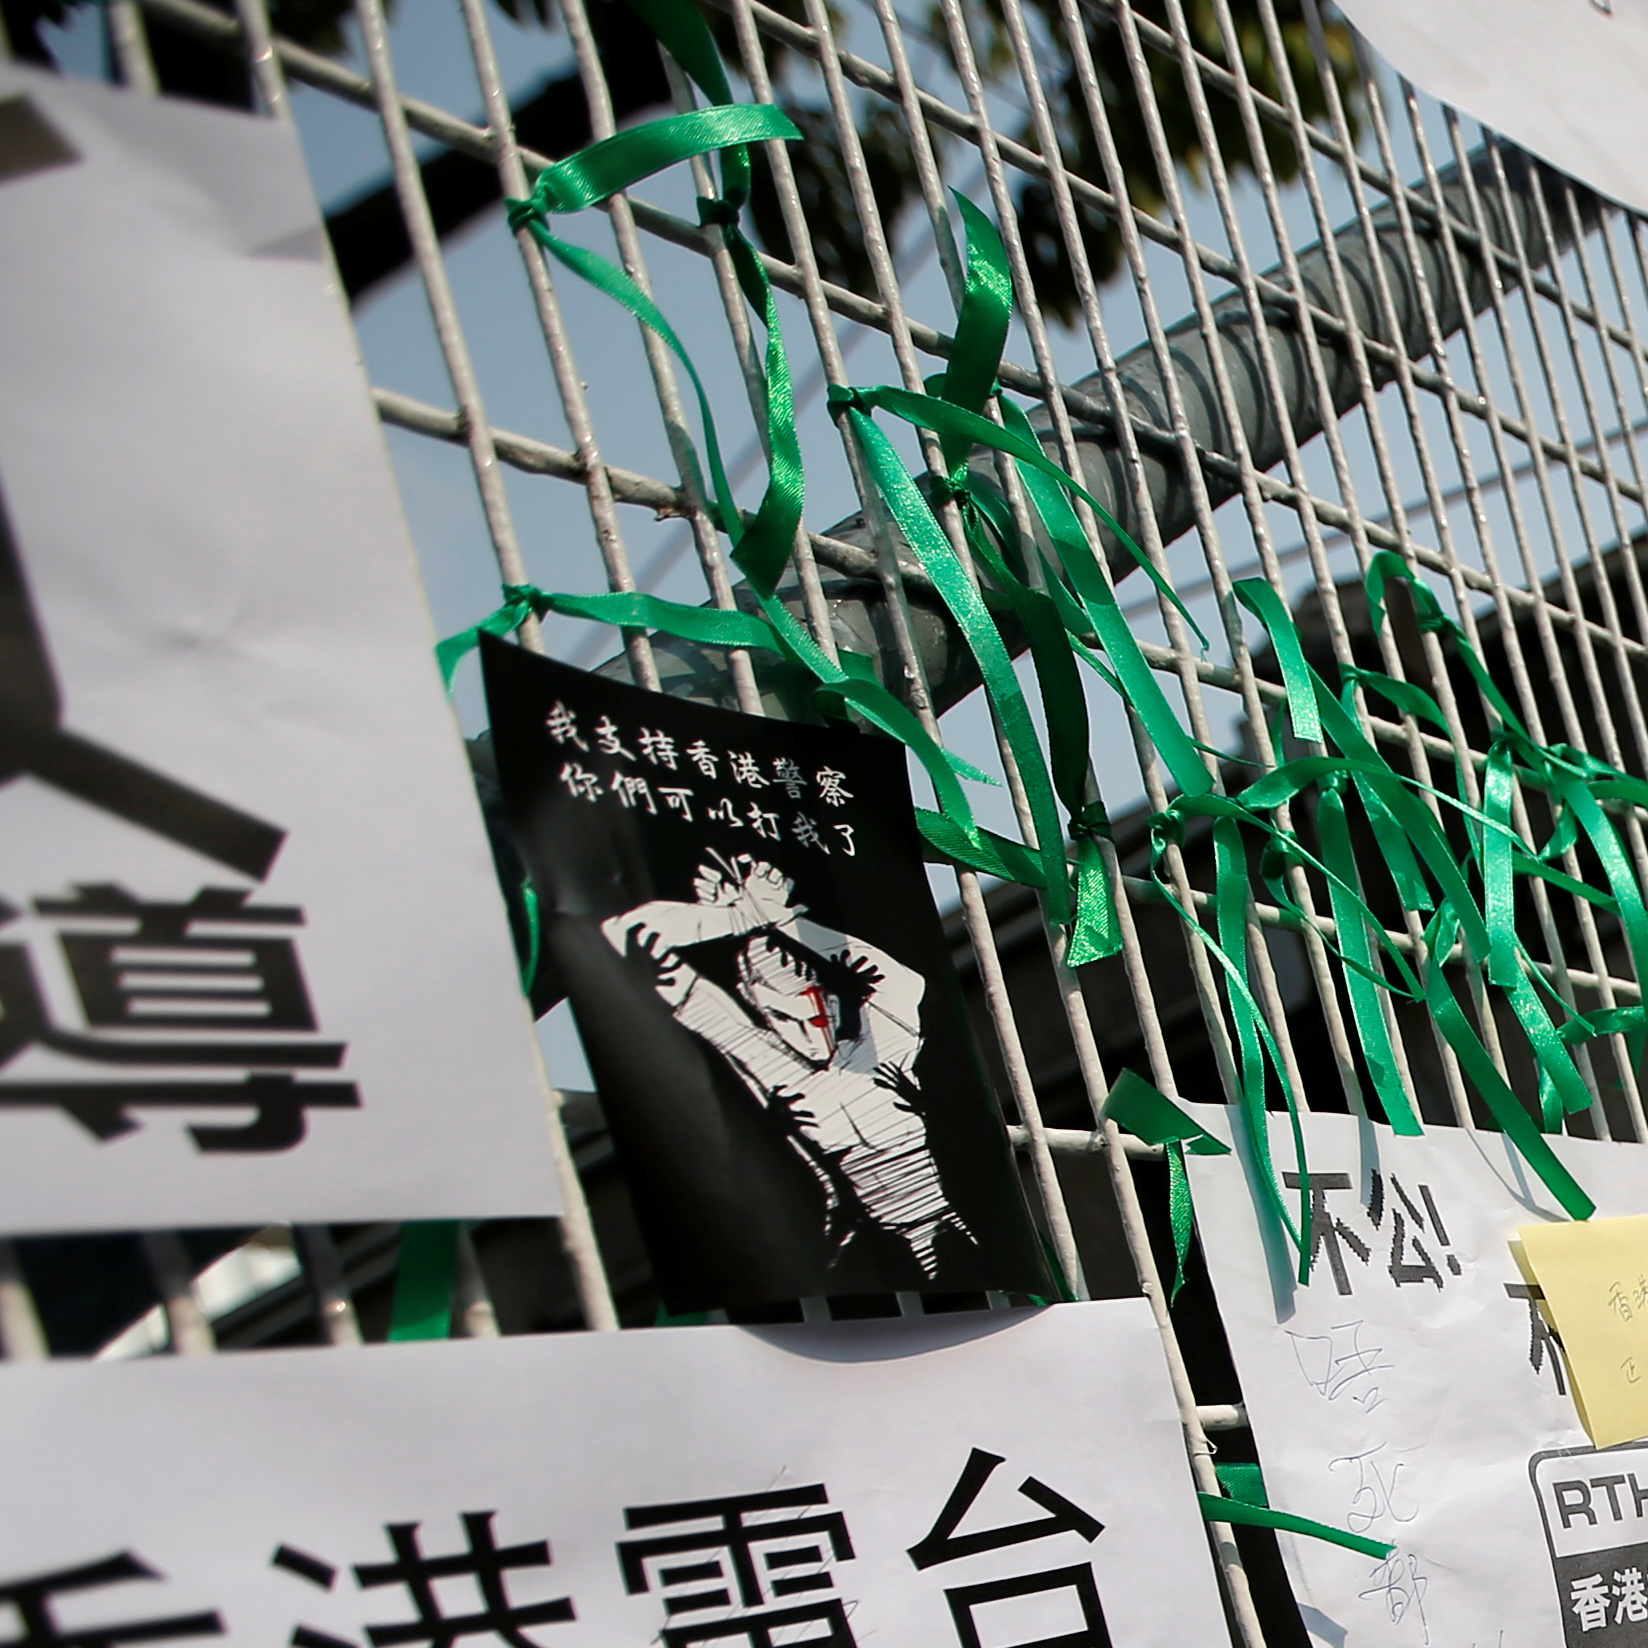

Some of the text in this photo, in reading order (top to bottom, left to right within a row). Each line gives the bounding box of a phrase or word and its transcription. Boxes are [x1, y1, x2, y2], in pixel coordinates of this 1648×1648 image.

[547, 701, 855, 802] 我支持香港警察
[560, 763, 857, 858] 你們可以打我了
[1281, 1165, 1464, 1297] 不公!
